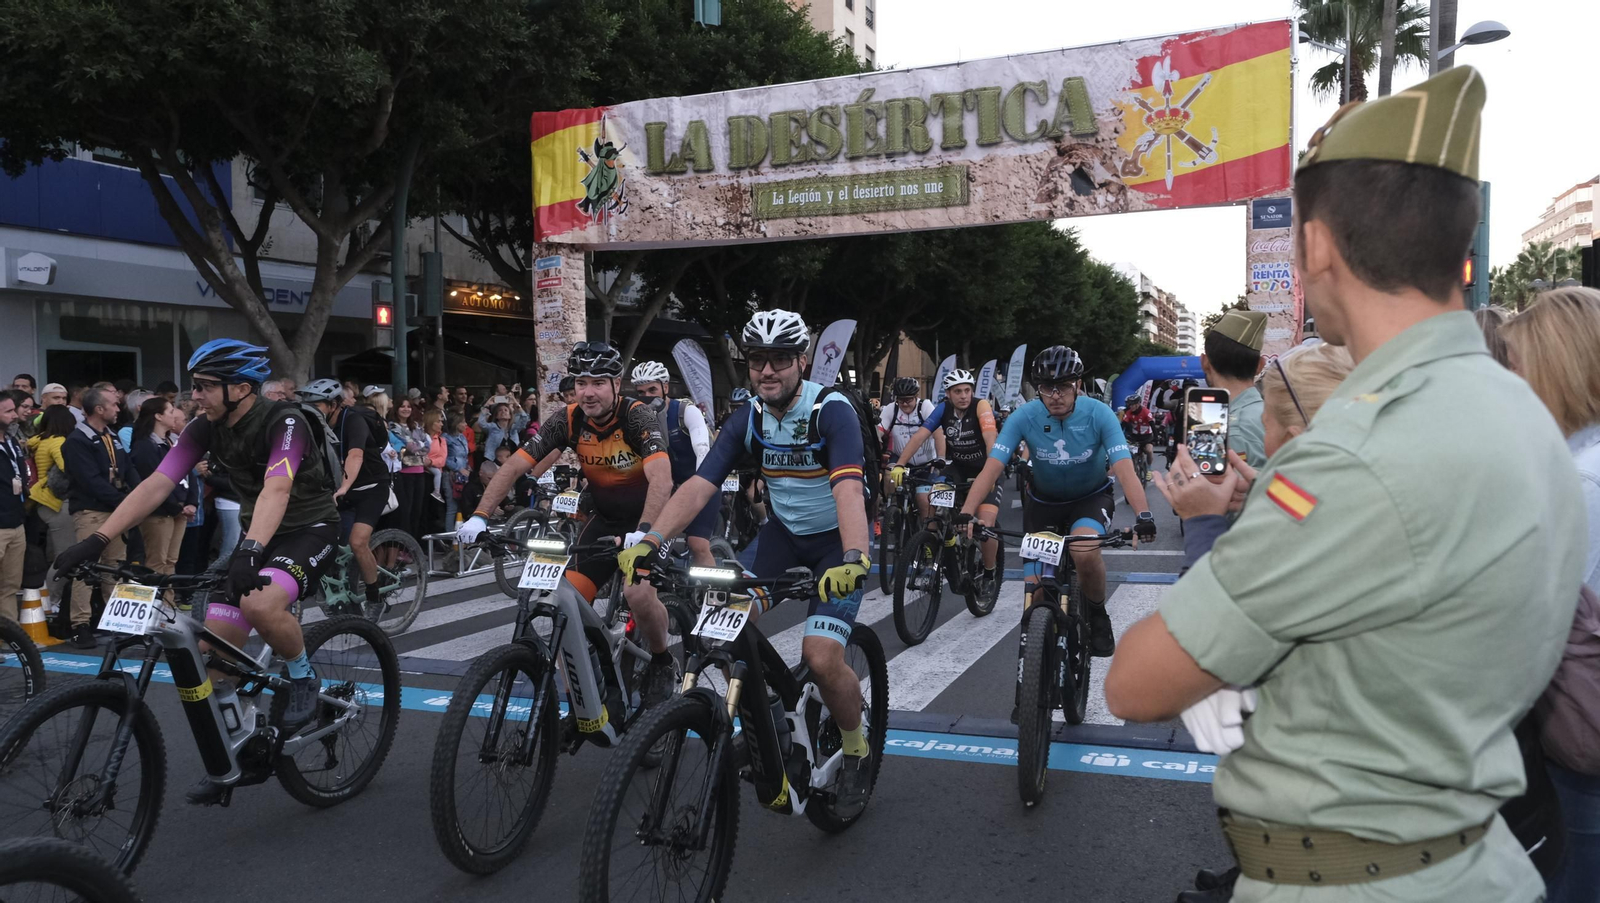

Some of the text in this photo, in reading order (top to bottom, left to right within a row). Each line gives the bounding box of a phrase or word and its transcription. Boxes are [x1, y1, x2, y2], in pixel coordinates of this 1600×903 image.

[645, 76, 1099, 174] LA DESÉRTICA
[772, 181, 944, 206] La Legión y el desierto nos une
[1253, 262, 1290, 270] GRUPO
[1253, 270, 1290, 279] RENTA
[196, 280, 314, 306] VIDEN
[1253, 280, 1290, 292] TODO
[539, 330, 560, 340] BBVA
[556, 496, 577, 507] 10056
[1026, 537, 1060, 555] 10123
[527, 563, 561, 579] 10118
[108, 600, 148, 621] 10076
[111, 622, 136, 632] cajamar
[814, 621, 825, 630] LA
[563, 647, 585, 710] SCOTT
[885, 739, 1018, 755] cajama
[1141, 760, 1217, 774] caja
